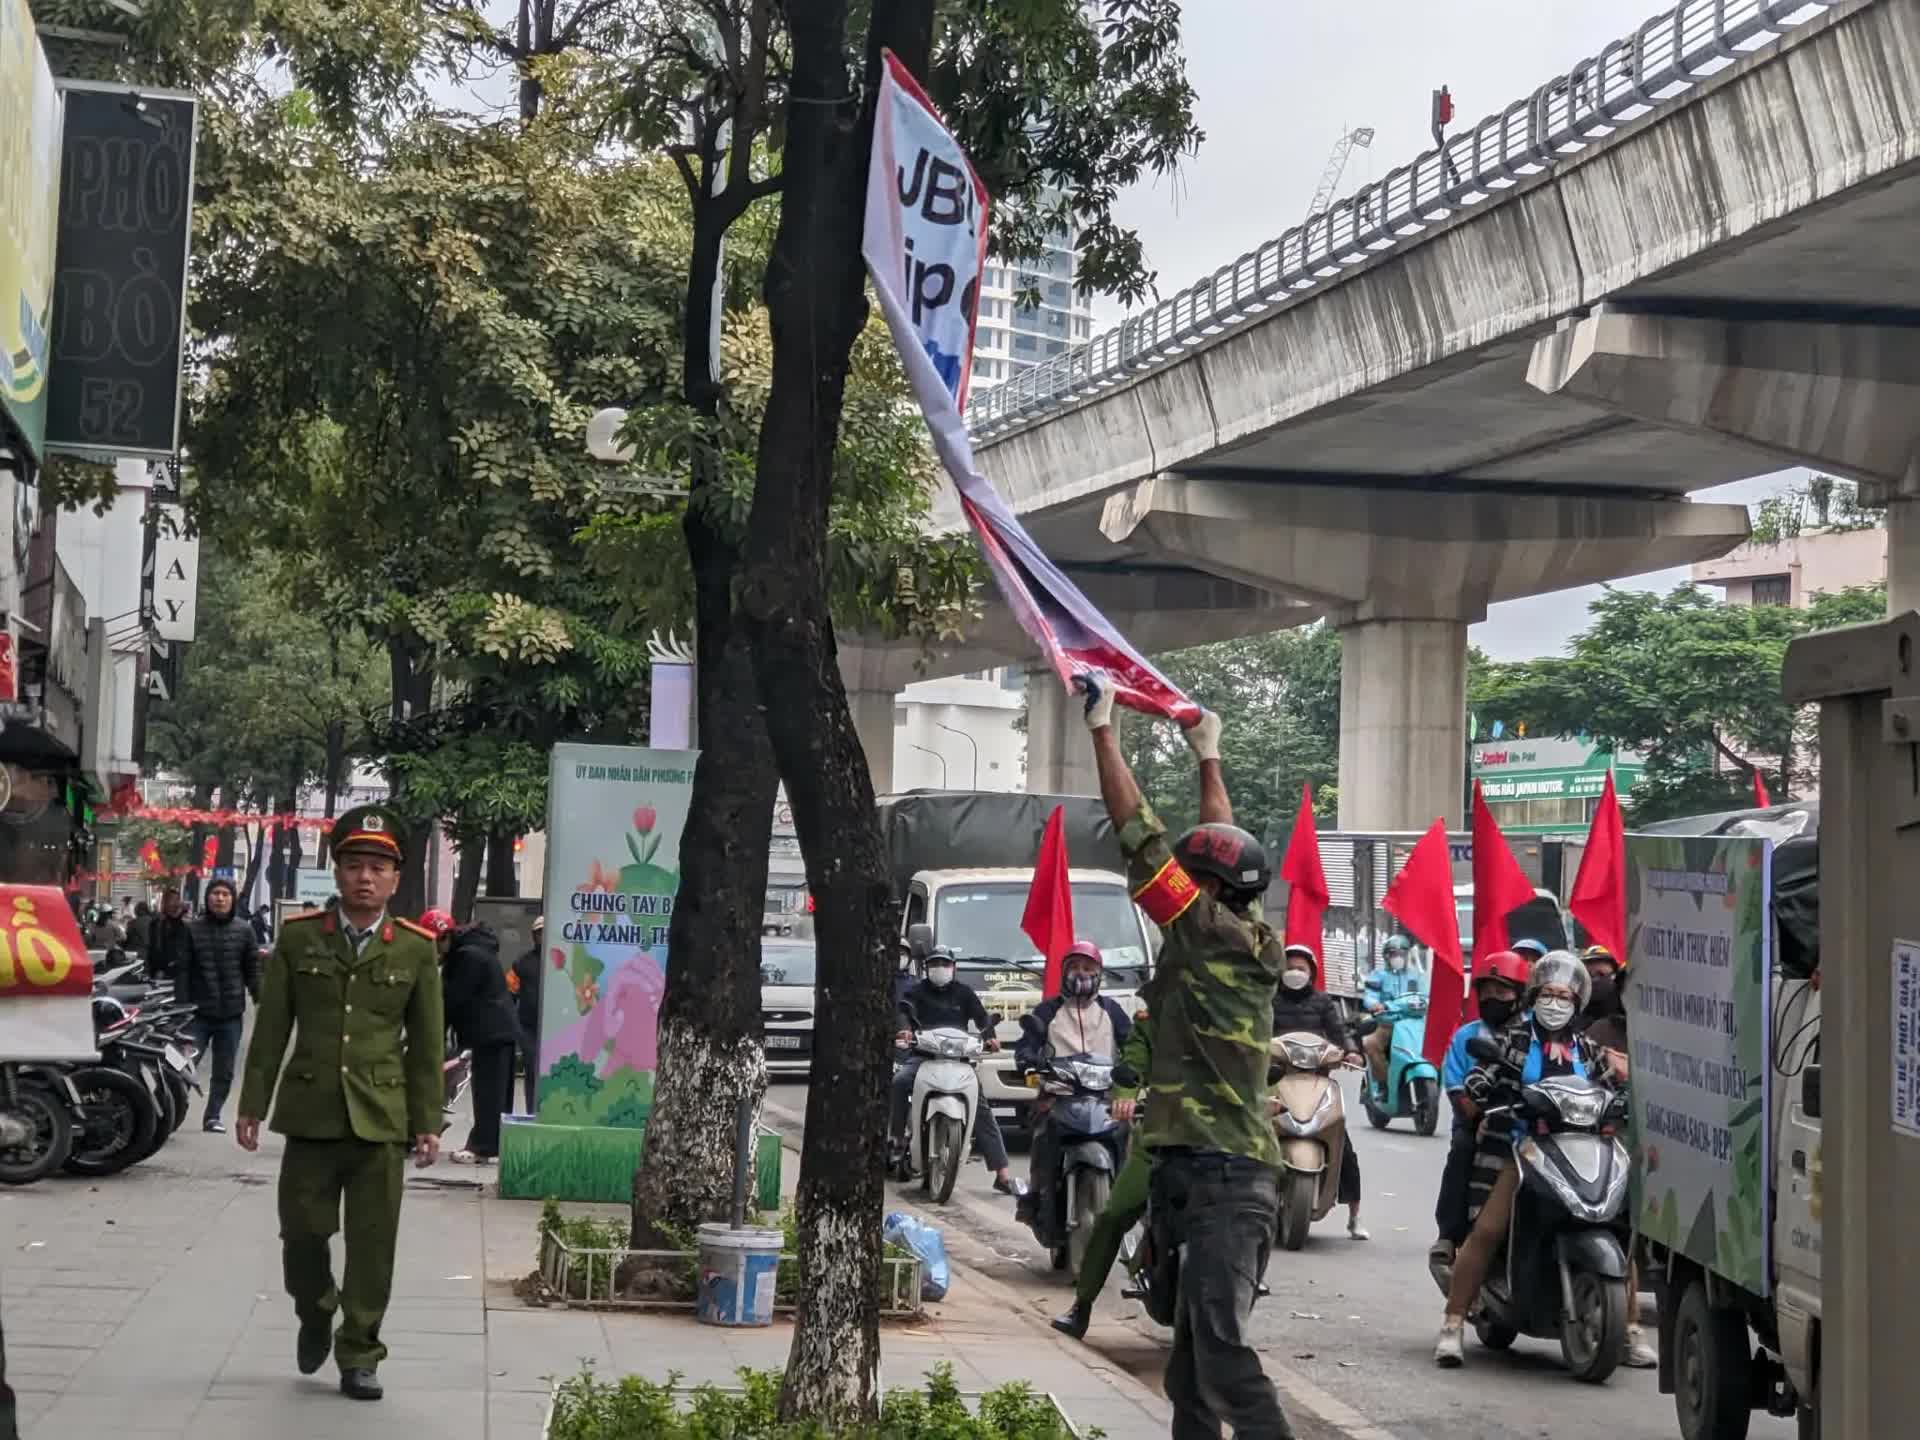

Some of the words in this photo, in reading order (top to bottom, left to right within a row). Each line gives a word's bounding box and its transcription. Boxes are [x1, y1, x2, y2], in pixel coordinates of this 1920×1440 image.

[58, 248, 177, 367] BÒ
[80, 376, 144, 442] 52
[570, 892, 626, 913] CHUNG
[631, 895, 658, 914] TAY
[562, 919, 593, 942] CÂY
[597, 924, 645, 945] XANH,
